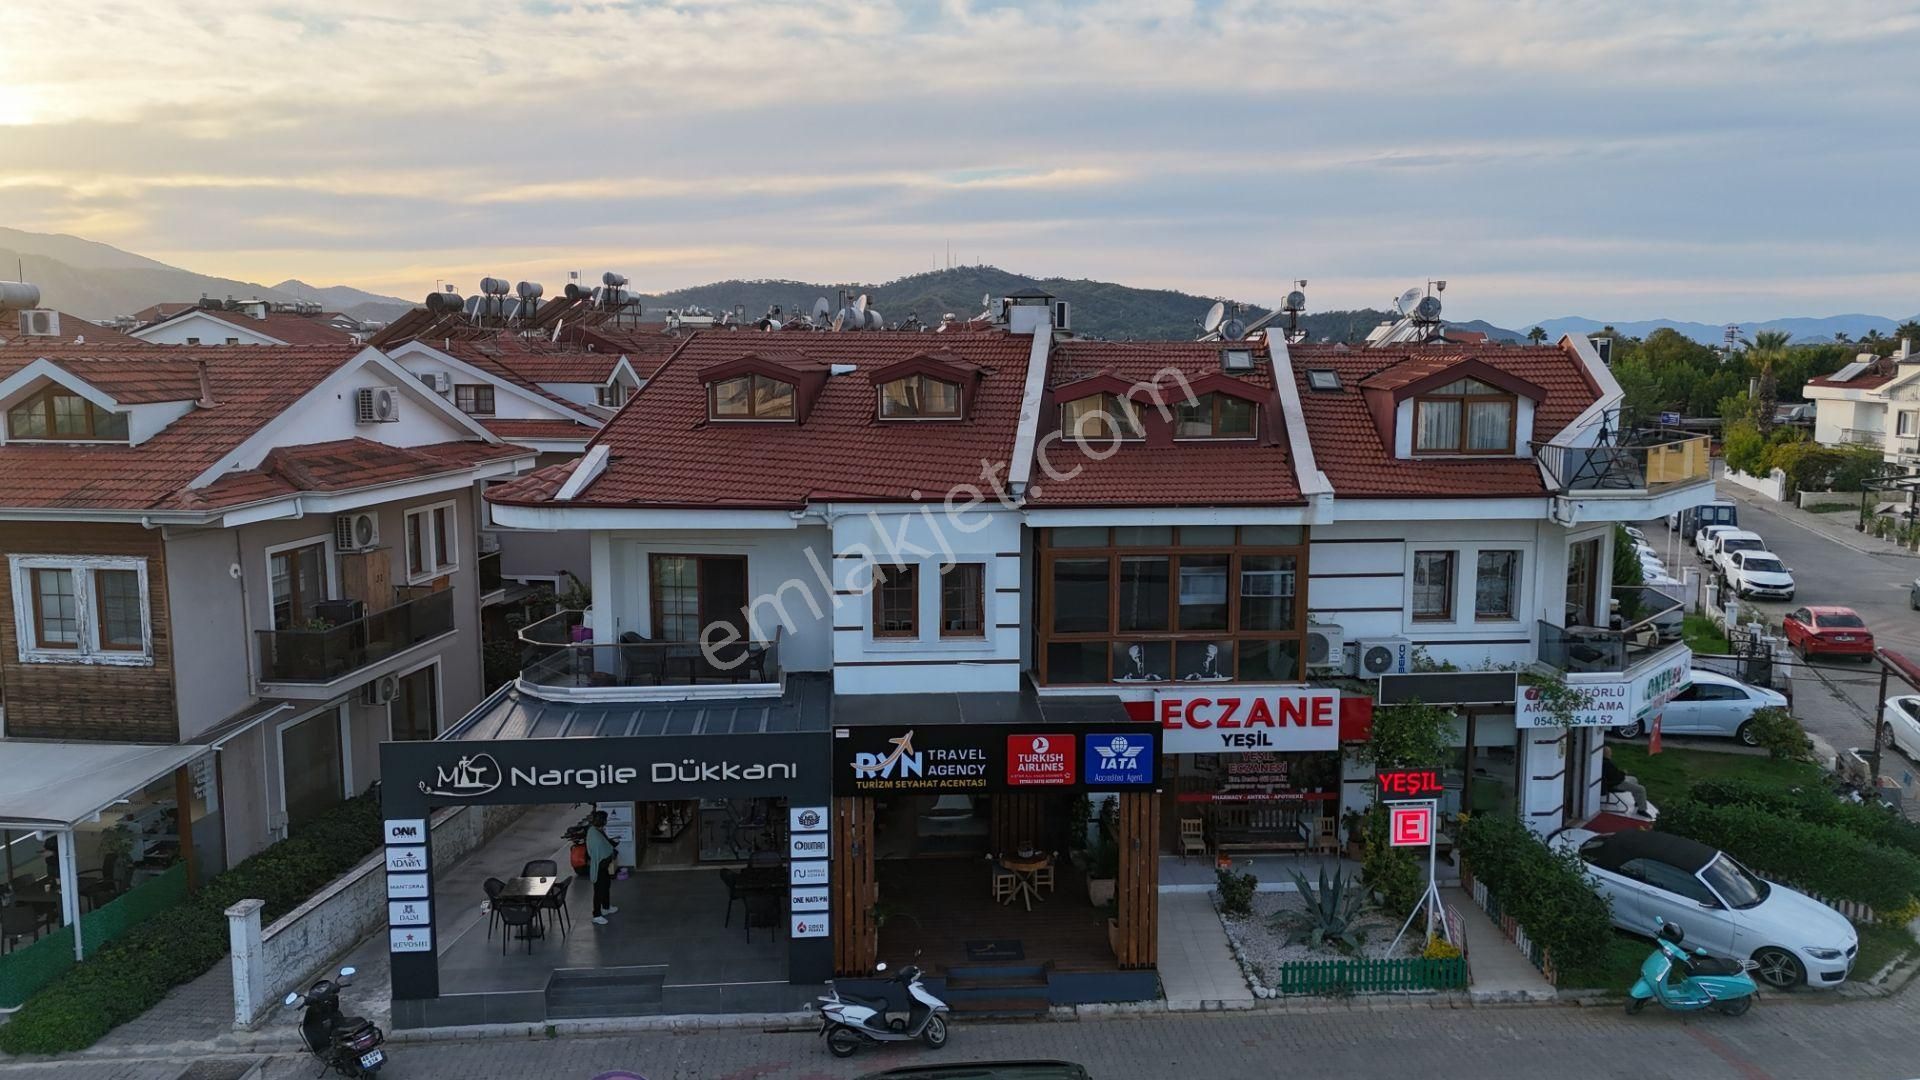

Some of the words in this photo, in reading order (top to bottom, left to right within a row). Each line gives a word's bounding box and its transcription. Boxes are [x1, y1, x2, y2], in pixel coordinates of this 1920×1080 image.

[1162, 696, 1334, 730] ECZANE
[1584, 714, 1597, 725] 44
[1600, 714, 1613, 725] 52
[1221, 730, 1273, 749] YEŞİL
[928, 749, 987, 760] TRAVEL
[1018, 753, 1064, 762] TURKISH
[1018, 763, 1064, 772] AIRLINES
[1100, 758, 1137, 769] IATA
[511, 764, 637, 788] Nargile
[651, 759, 797, 782] Dükkanı
[927, 764, 986, 776] AGENCY
[1095, 773, 1122, 782] Accredited
[1127, 773, 1143, 783] Agent
[856, 779, 893, 789] TURİZM
[895, 779, 938, 789] SEYAHAT
[940, 779, 987, 788] ACENTASI
